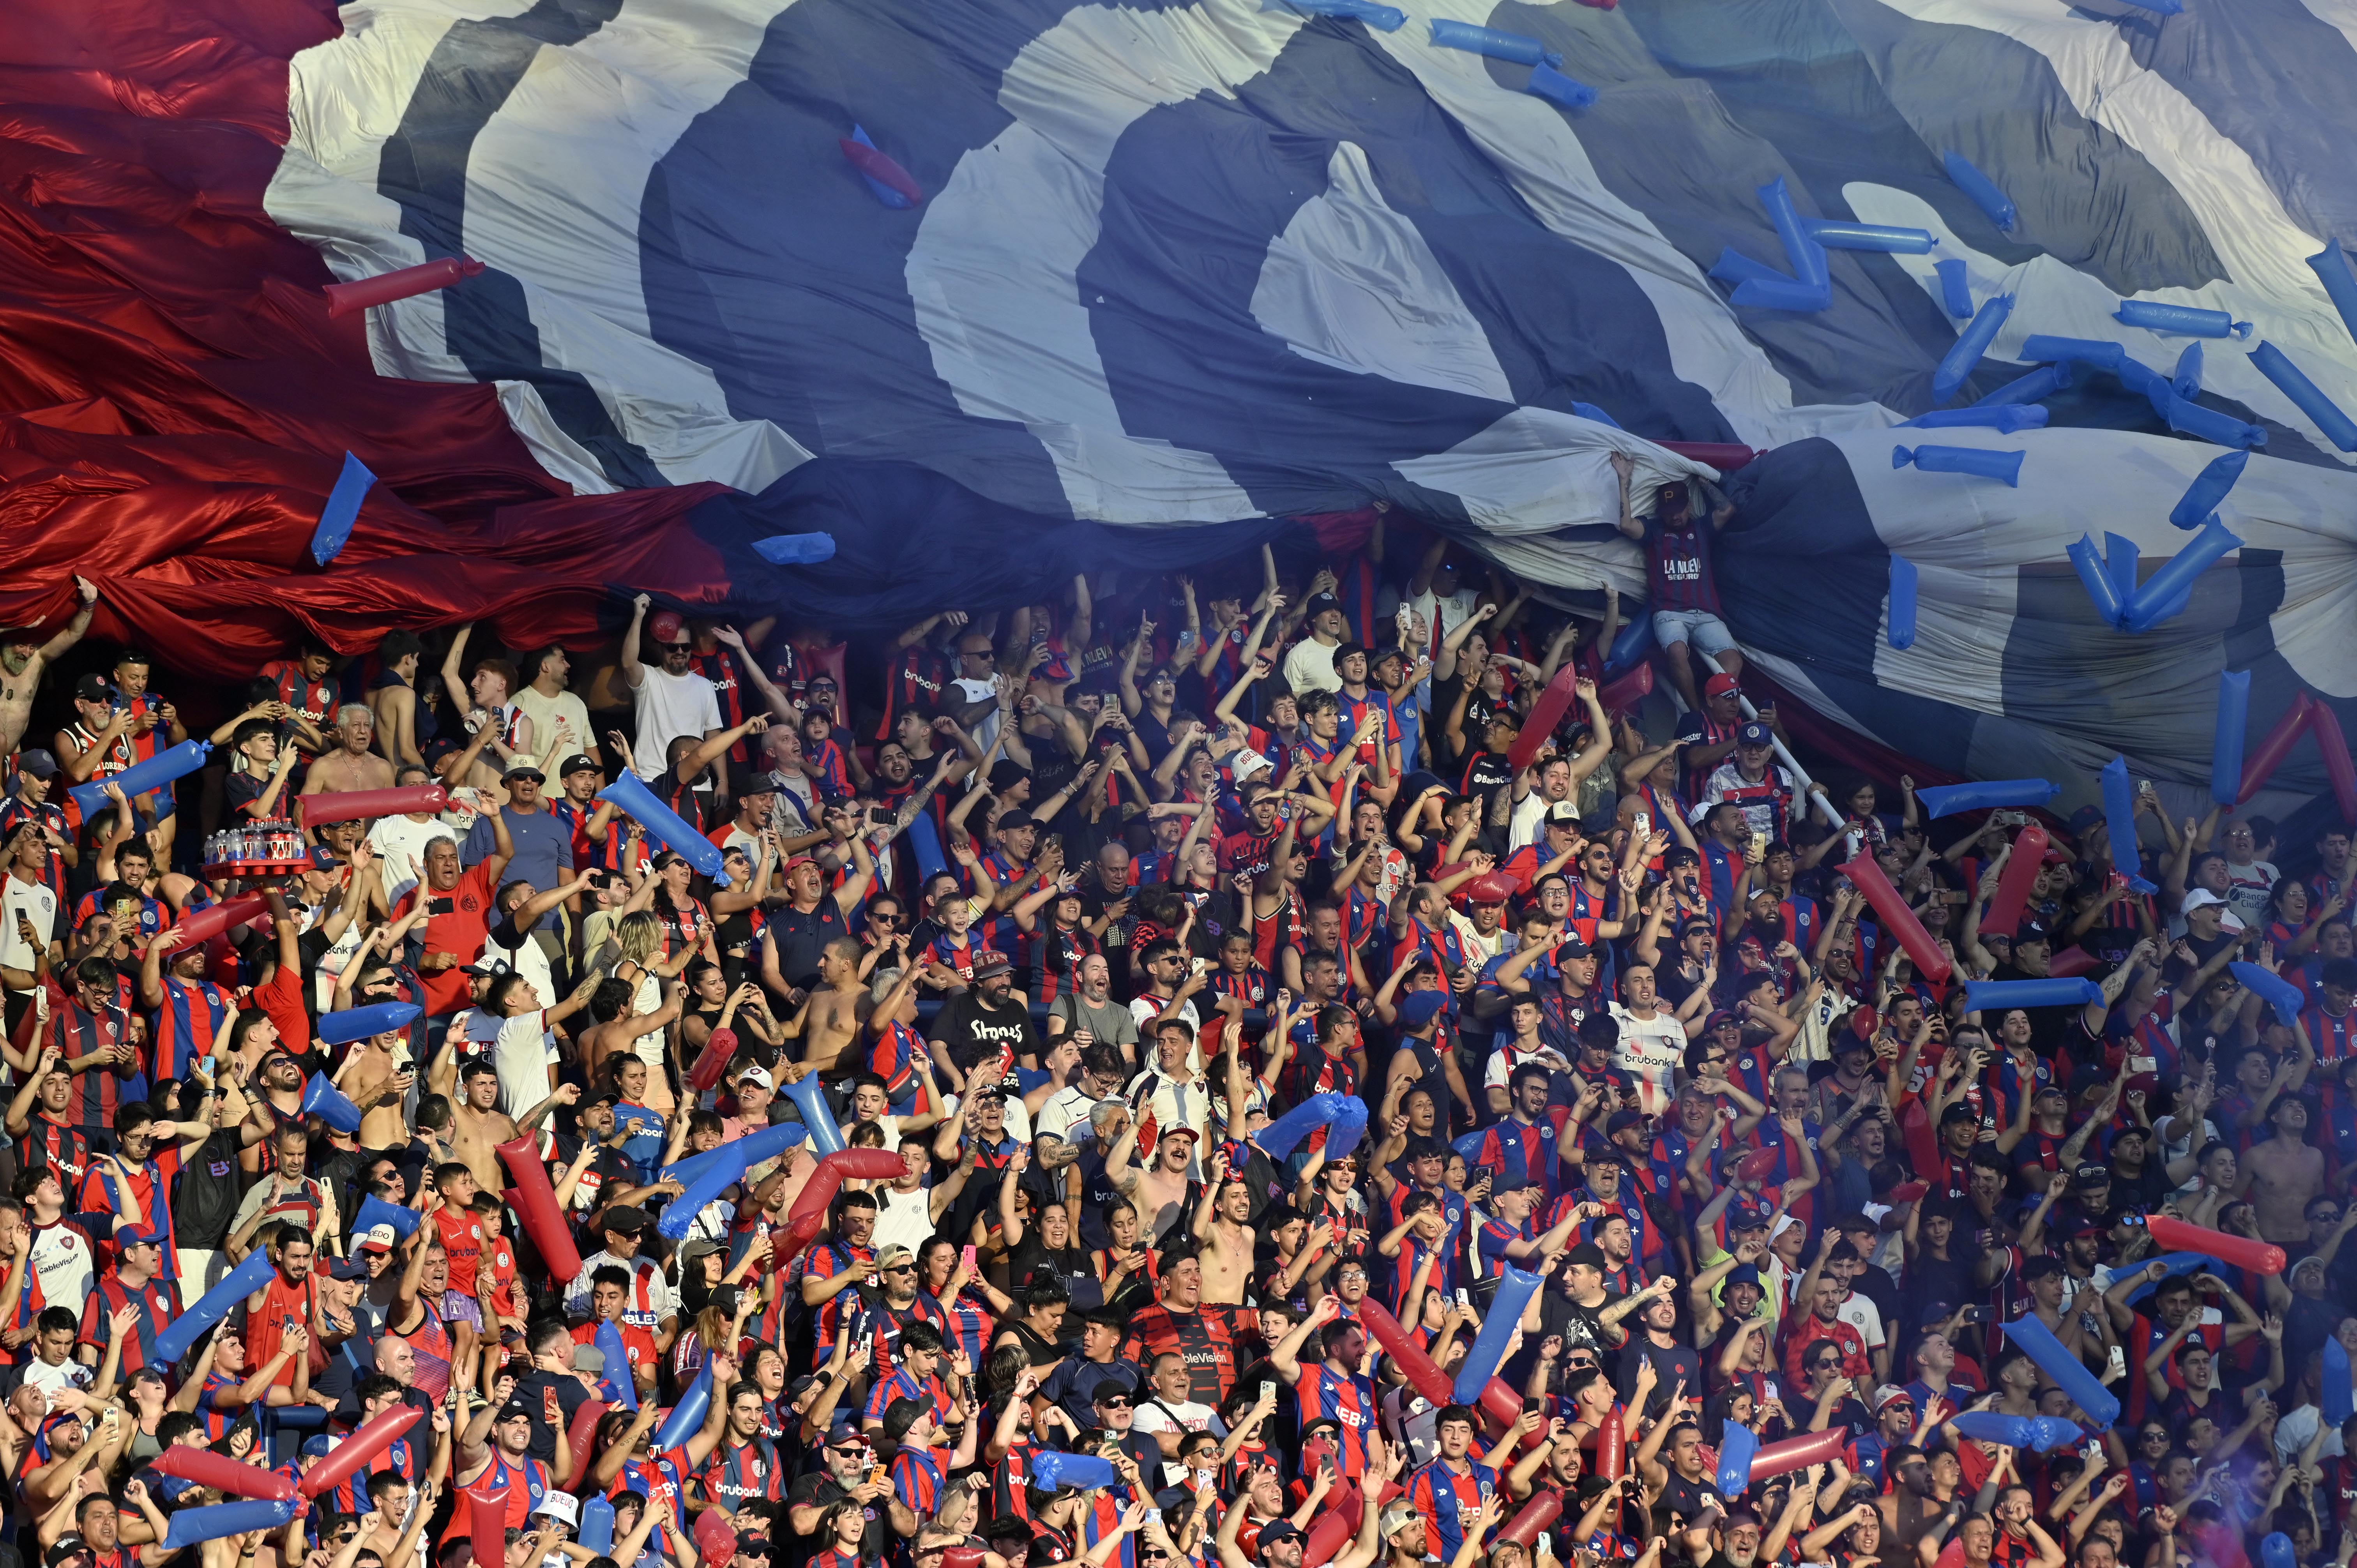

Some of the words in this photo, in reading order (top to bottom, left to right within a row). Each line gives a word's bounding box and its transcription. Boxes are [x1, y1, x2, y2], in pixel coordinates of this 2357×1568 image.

[1664, 560, 1675, 574] LA
[905, 669, 941, 692] brubank
[1240, 751, 1258, 765] BOED
[1735, 792, 1741, 803] 2
[971, 1019, 1022, 1043] Stones
[1623, 1052, 1671, 1068] brubank
[1182, 1351, 1226, 1365] bleVisión
[715, 1481, 762, 1497] brubank
[550, 1493, 573, 1509] BOEDO
